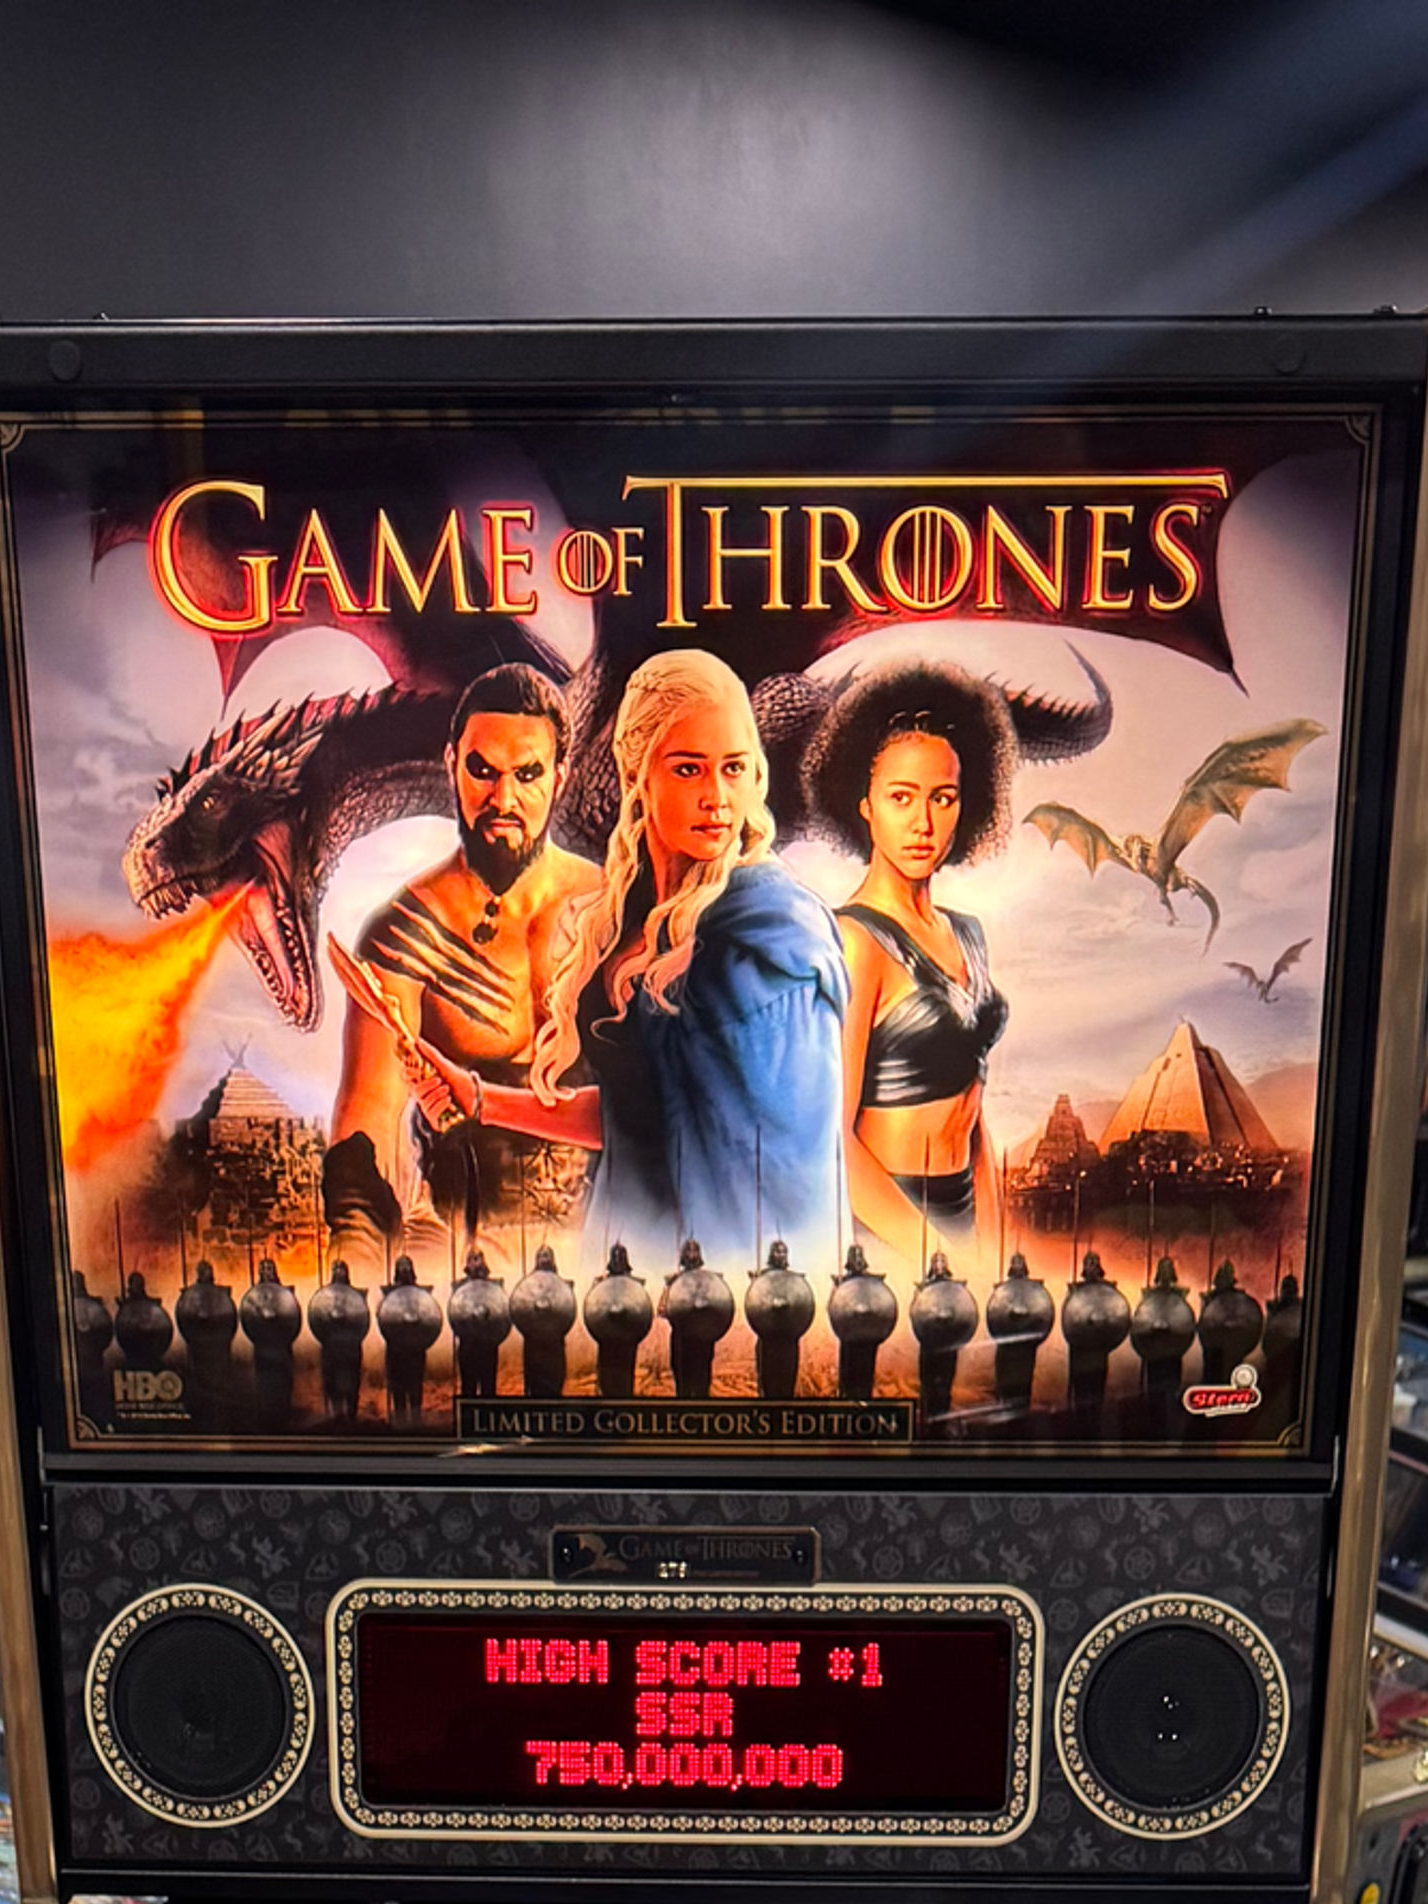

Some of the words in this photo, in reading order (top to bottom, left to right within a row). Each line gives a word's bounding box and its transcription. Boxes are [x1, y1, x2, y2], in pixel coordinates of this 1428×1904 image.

[152, 479, 537, 632] GAME
[556, 524, 643, 597] OF
[622, 474, 1228, 629] THRONES
[114, 1370, 183, 1402] HBO
[474, 1410, 584, 1433] LIMITED
[593, 1409, 771, 1434] COLLECTOR'S
[781, 1411, 897, 1435] EDITION
[619, 1536, 684, 1561] GAME
[698, 1535, 795, 1561] THRONES
[485, 1638, 609, 1684] HIGH
[635, 1640, 802, 1687] SCORE
[827, 1642, 883, 1687] #1
[635, 1691, 734, 1737] SSR
[525, 1741, 844, 1791] 750,000,000
